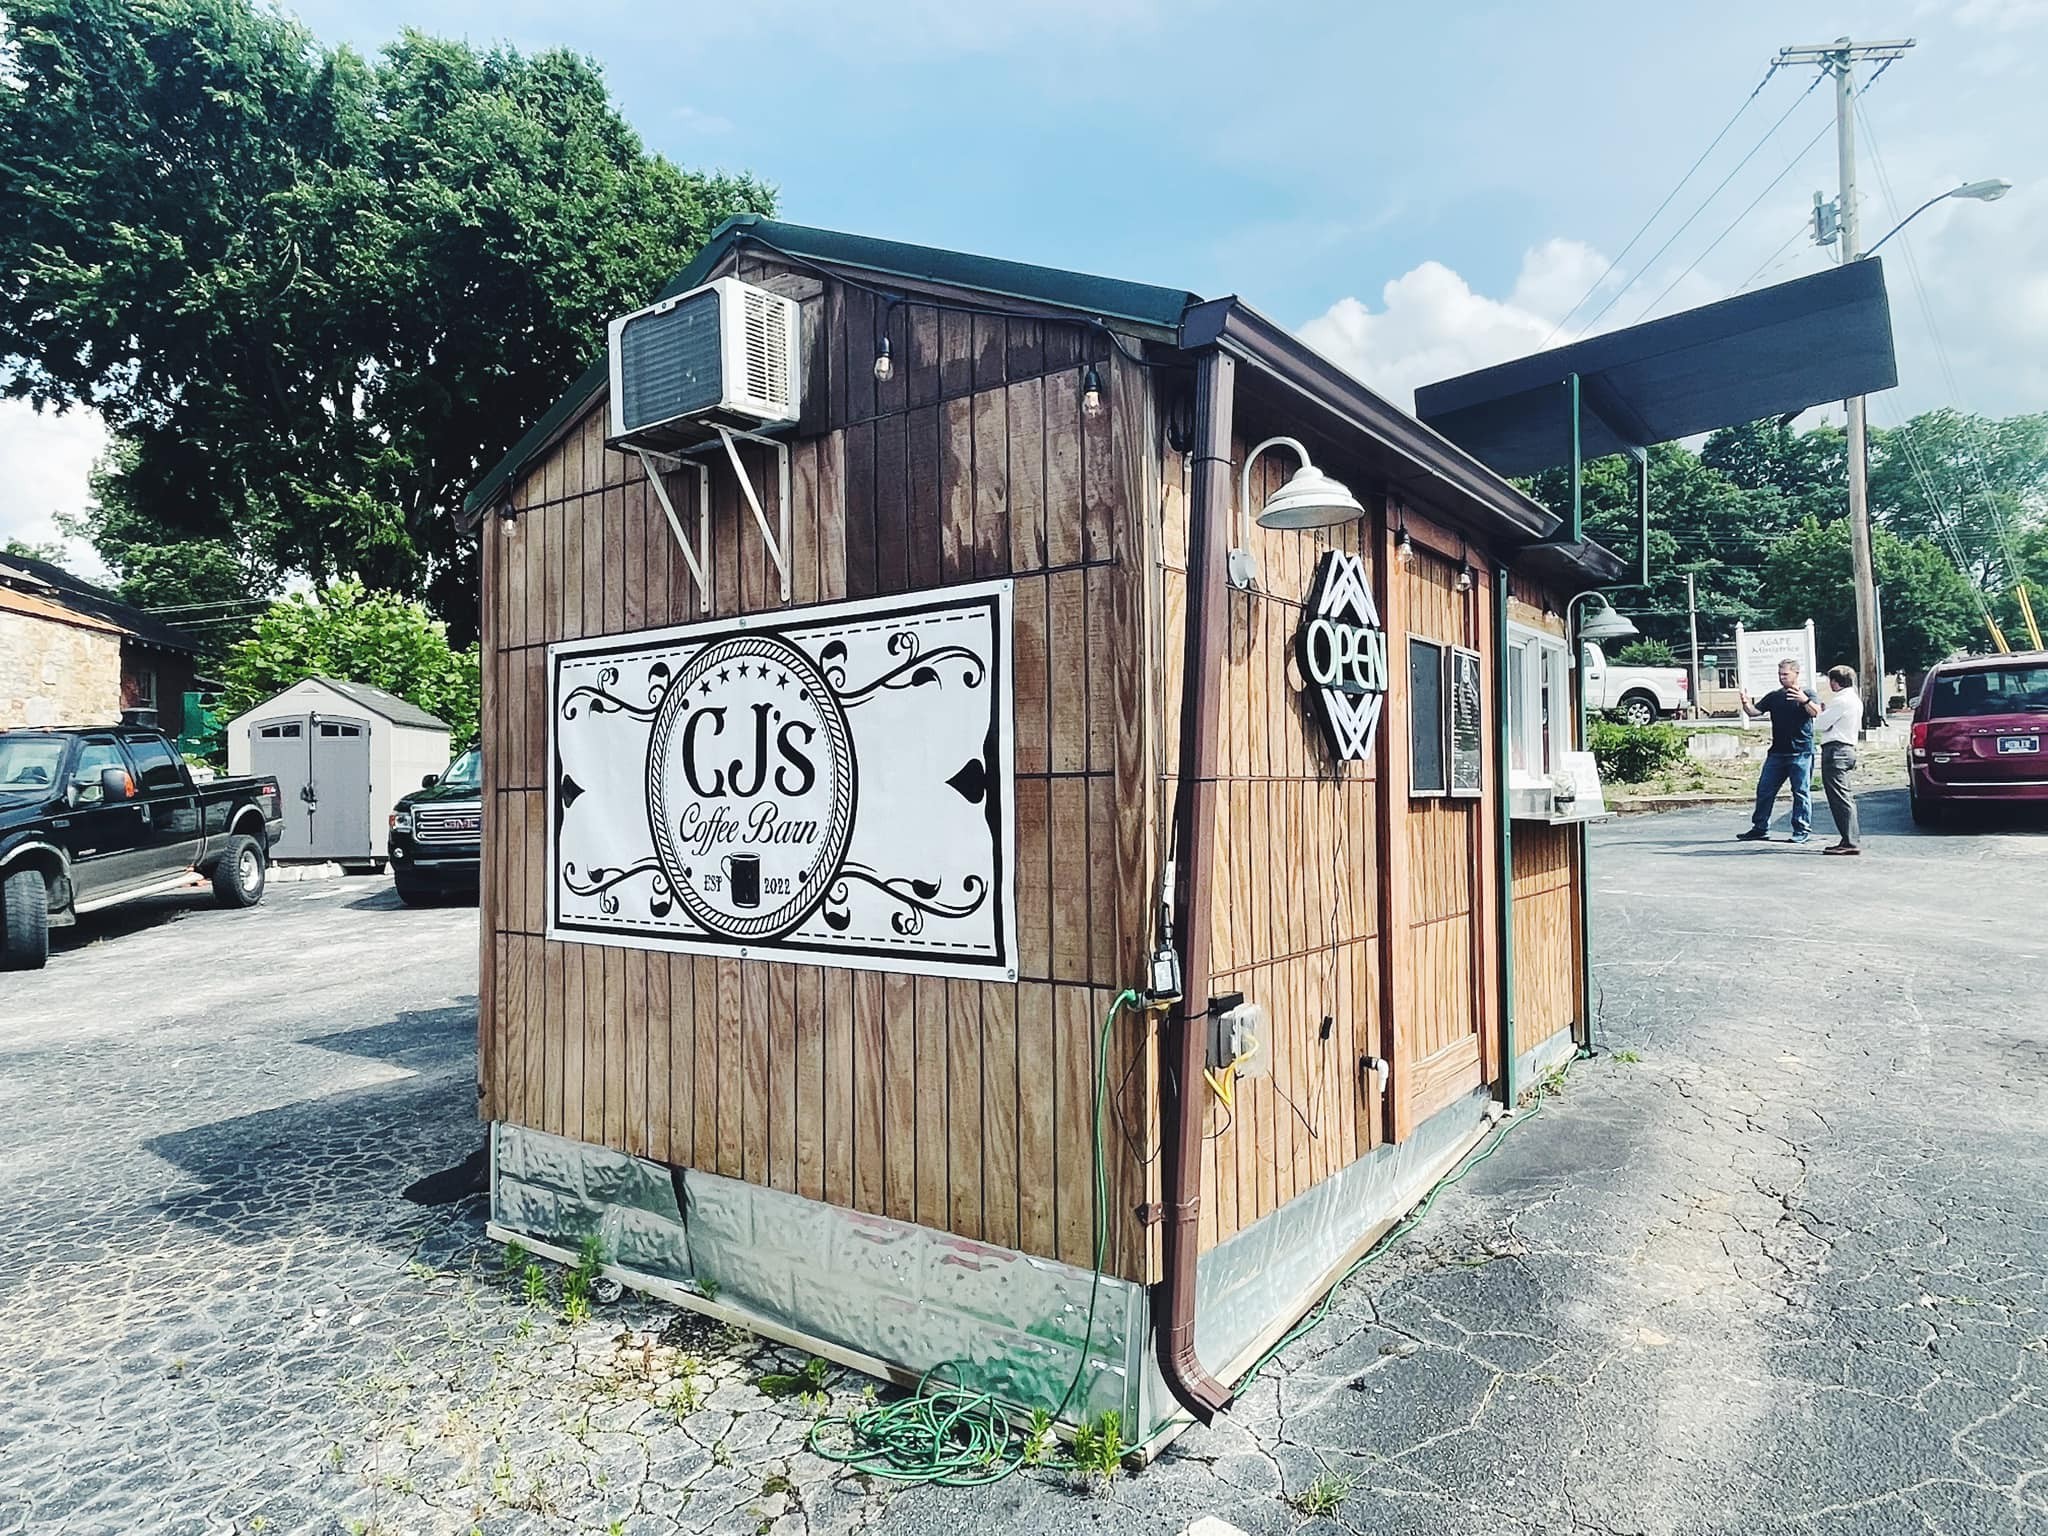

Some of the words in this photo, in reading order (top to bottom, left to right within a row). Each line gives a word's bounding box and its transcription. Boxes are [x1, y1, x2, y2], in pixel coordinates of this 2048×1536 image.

[1307, 619, 1387, 691] OPEN
[443, 818, 480, 829] GMC
[679, 801, 740, 856] Coffee
[742, 800, 819, 844] Barn
[704, 874, 722, 892] EST
[764, 877, 791, 895] 2022
